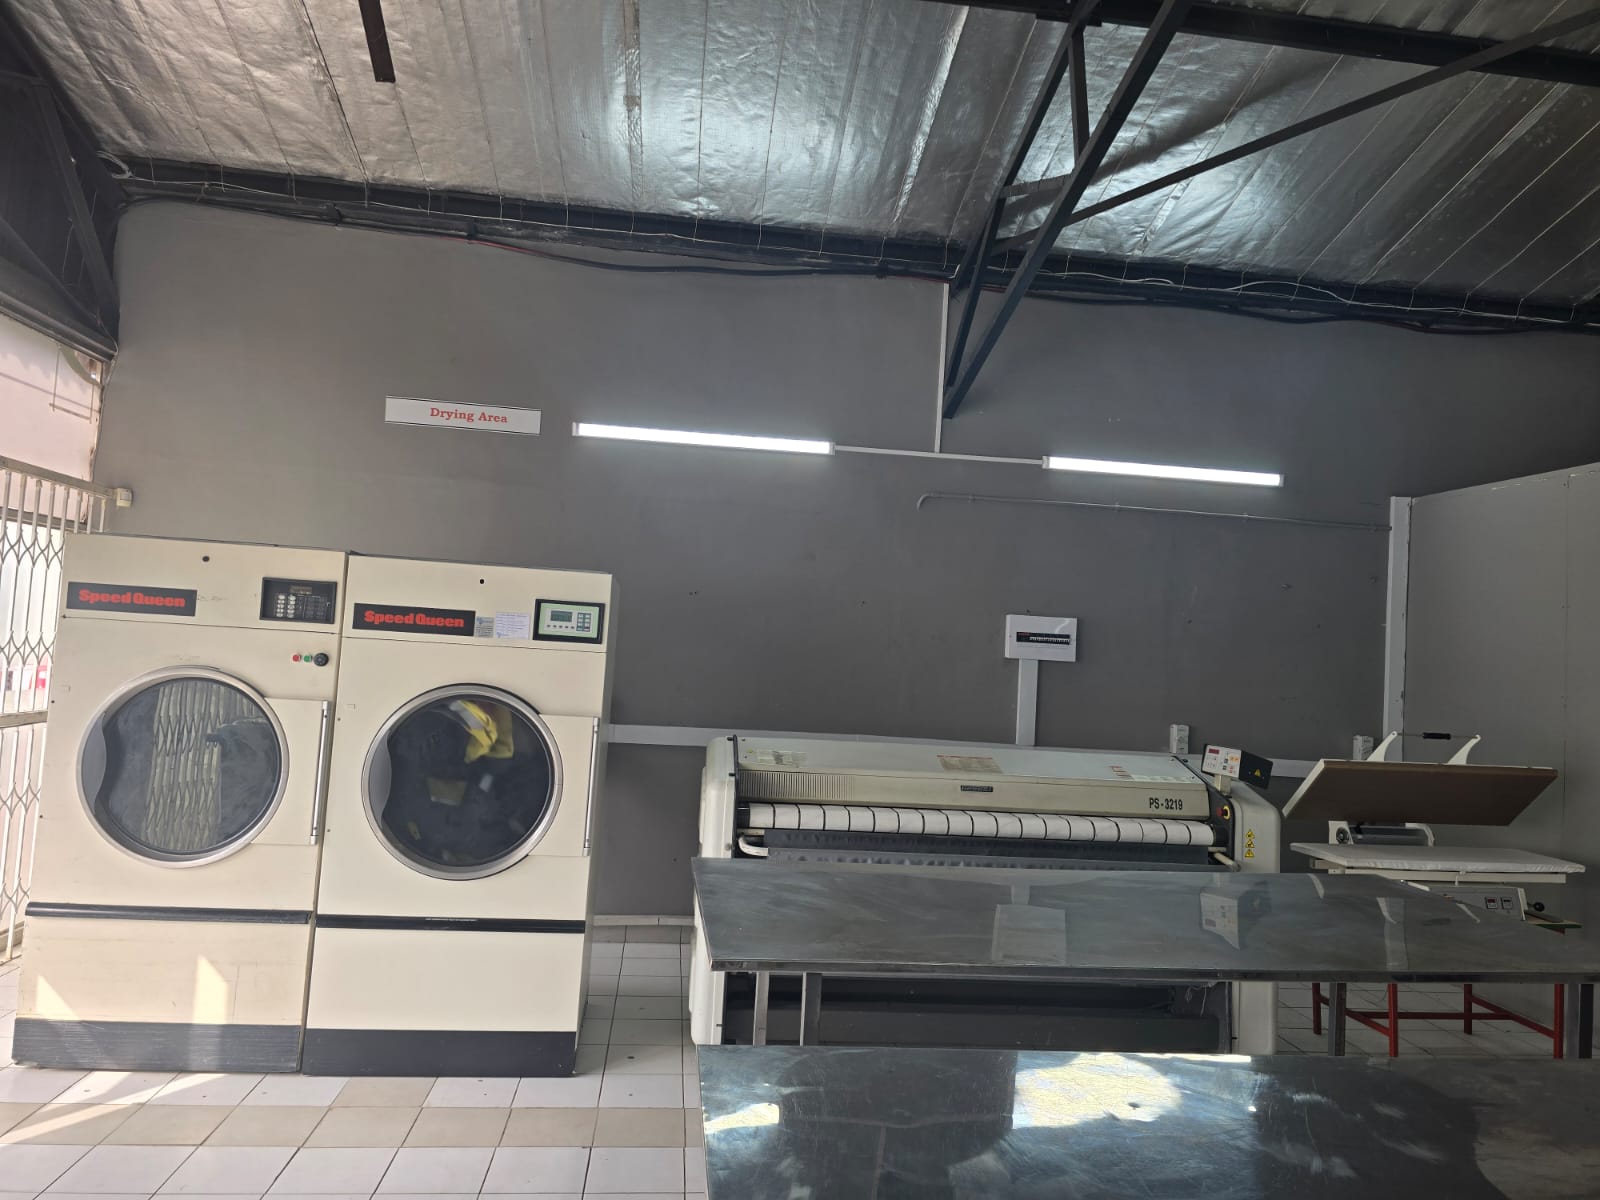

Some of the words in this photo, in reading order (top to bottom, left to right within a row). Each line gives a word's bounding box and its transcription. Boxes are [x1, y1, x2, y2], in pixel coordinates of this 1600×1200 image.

[430, 407, 474, 422] Drying
[478, 411, 508, 423] Area
[79, 589, 131, 604] Speed
[133, 592, 185, 607] Queen
[364, 610, 414, 624] Speed
[415, 613, 464, 627] Queen
